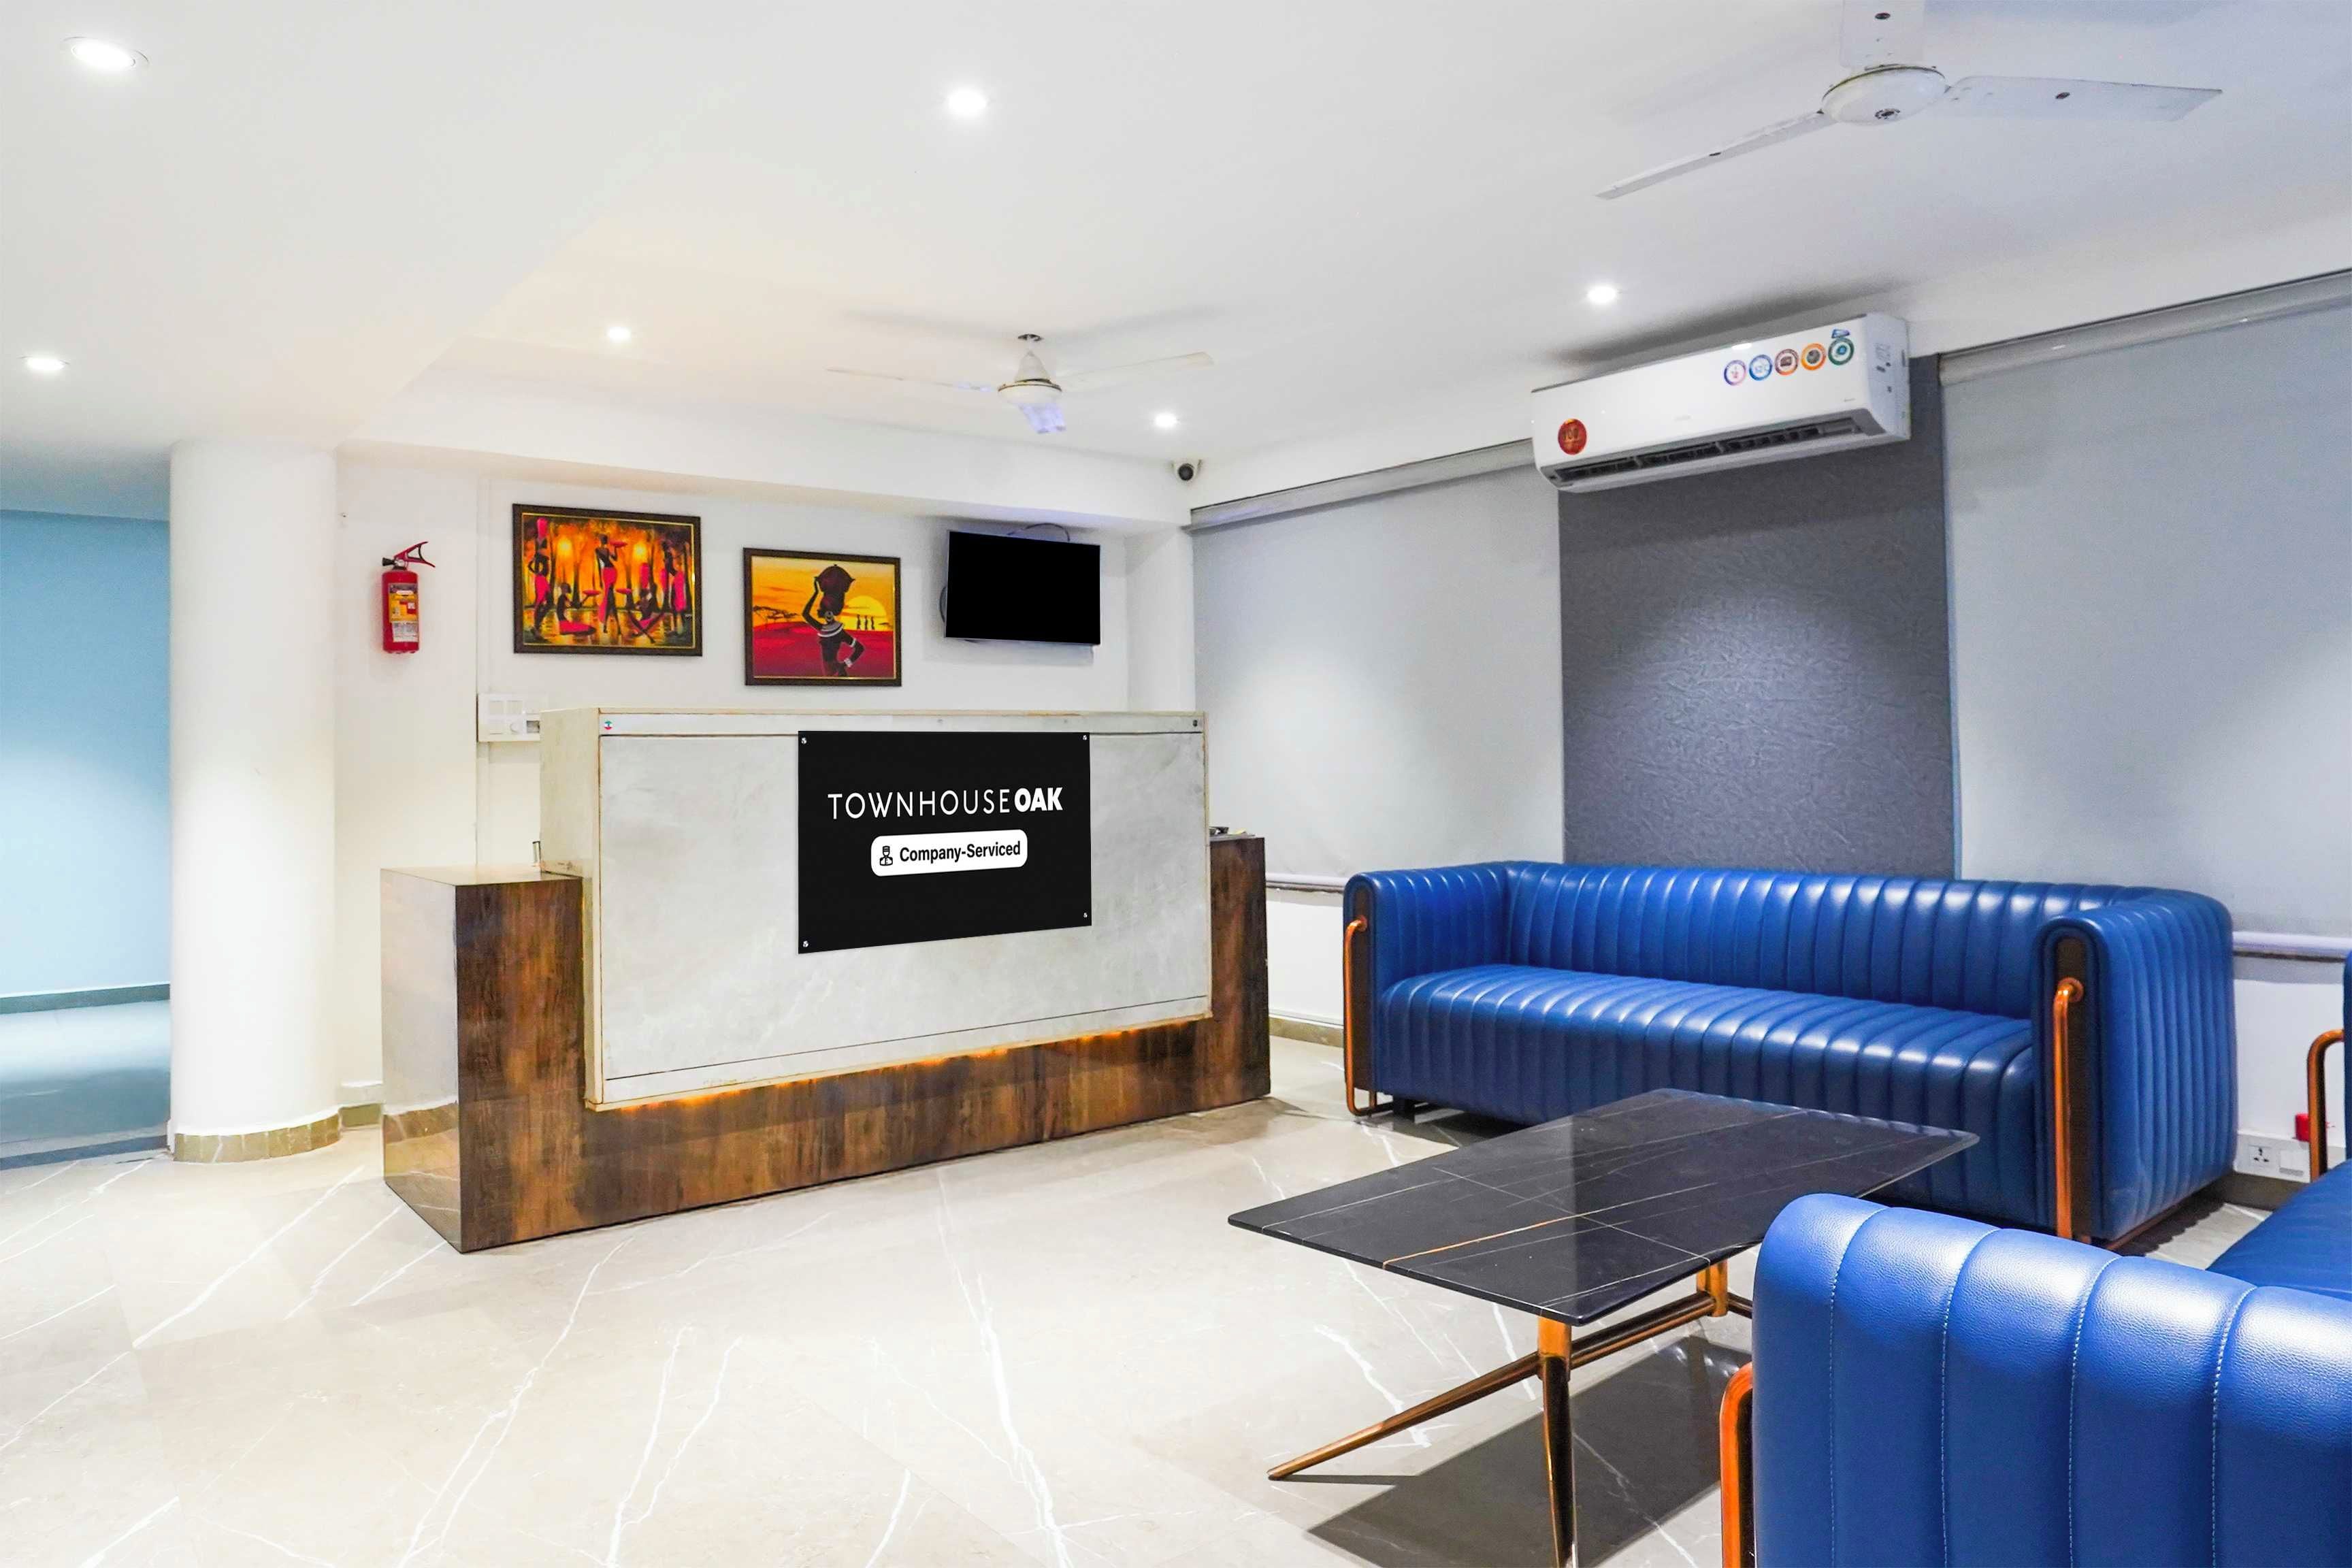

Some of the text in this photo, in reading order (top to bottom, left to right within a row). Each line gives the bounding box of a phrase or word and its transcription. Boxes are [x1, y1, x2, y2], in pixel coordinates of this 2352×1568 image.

[828, 787, 1063, 819] TOWNHOUSE OAK
[900, 840, 1021, 864] Company-Serviced
